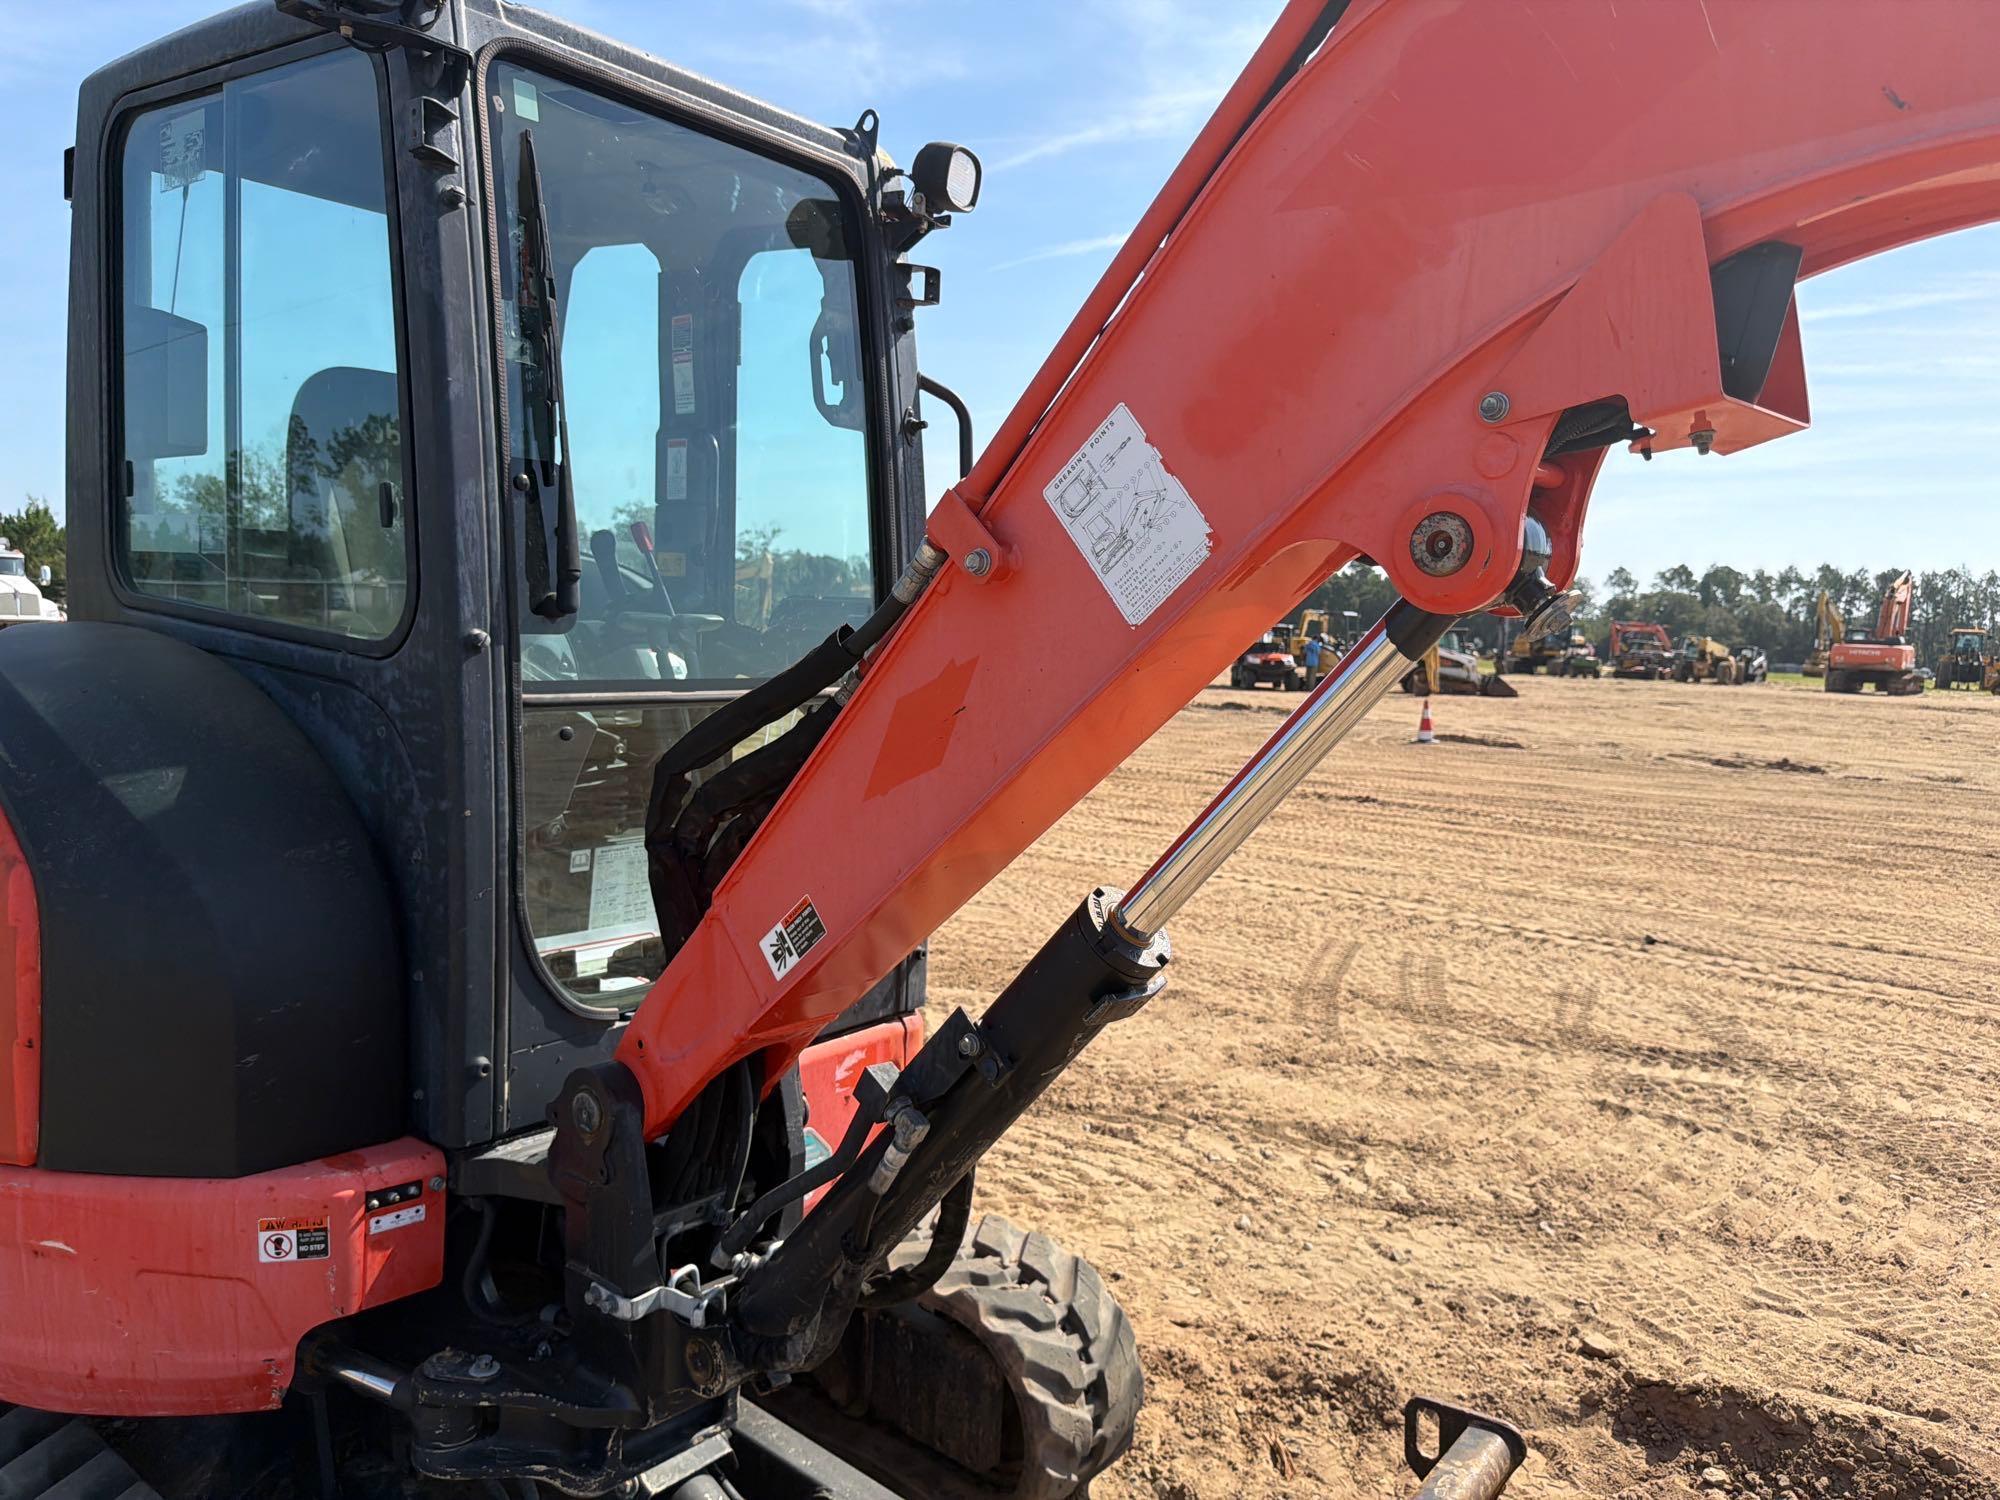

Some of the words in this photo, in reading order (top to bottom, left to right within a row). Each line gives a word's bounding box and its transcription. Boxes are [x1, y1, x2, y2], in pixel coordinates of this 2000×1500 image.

[1052, 451, 1088, 489] GREASING
[1088, 419, 1115, 449] POINTS
[299, 1244, 308, 1252] NO
